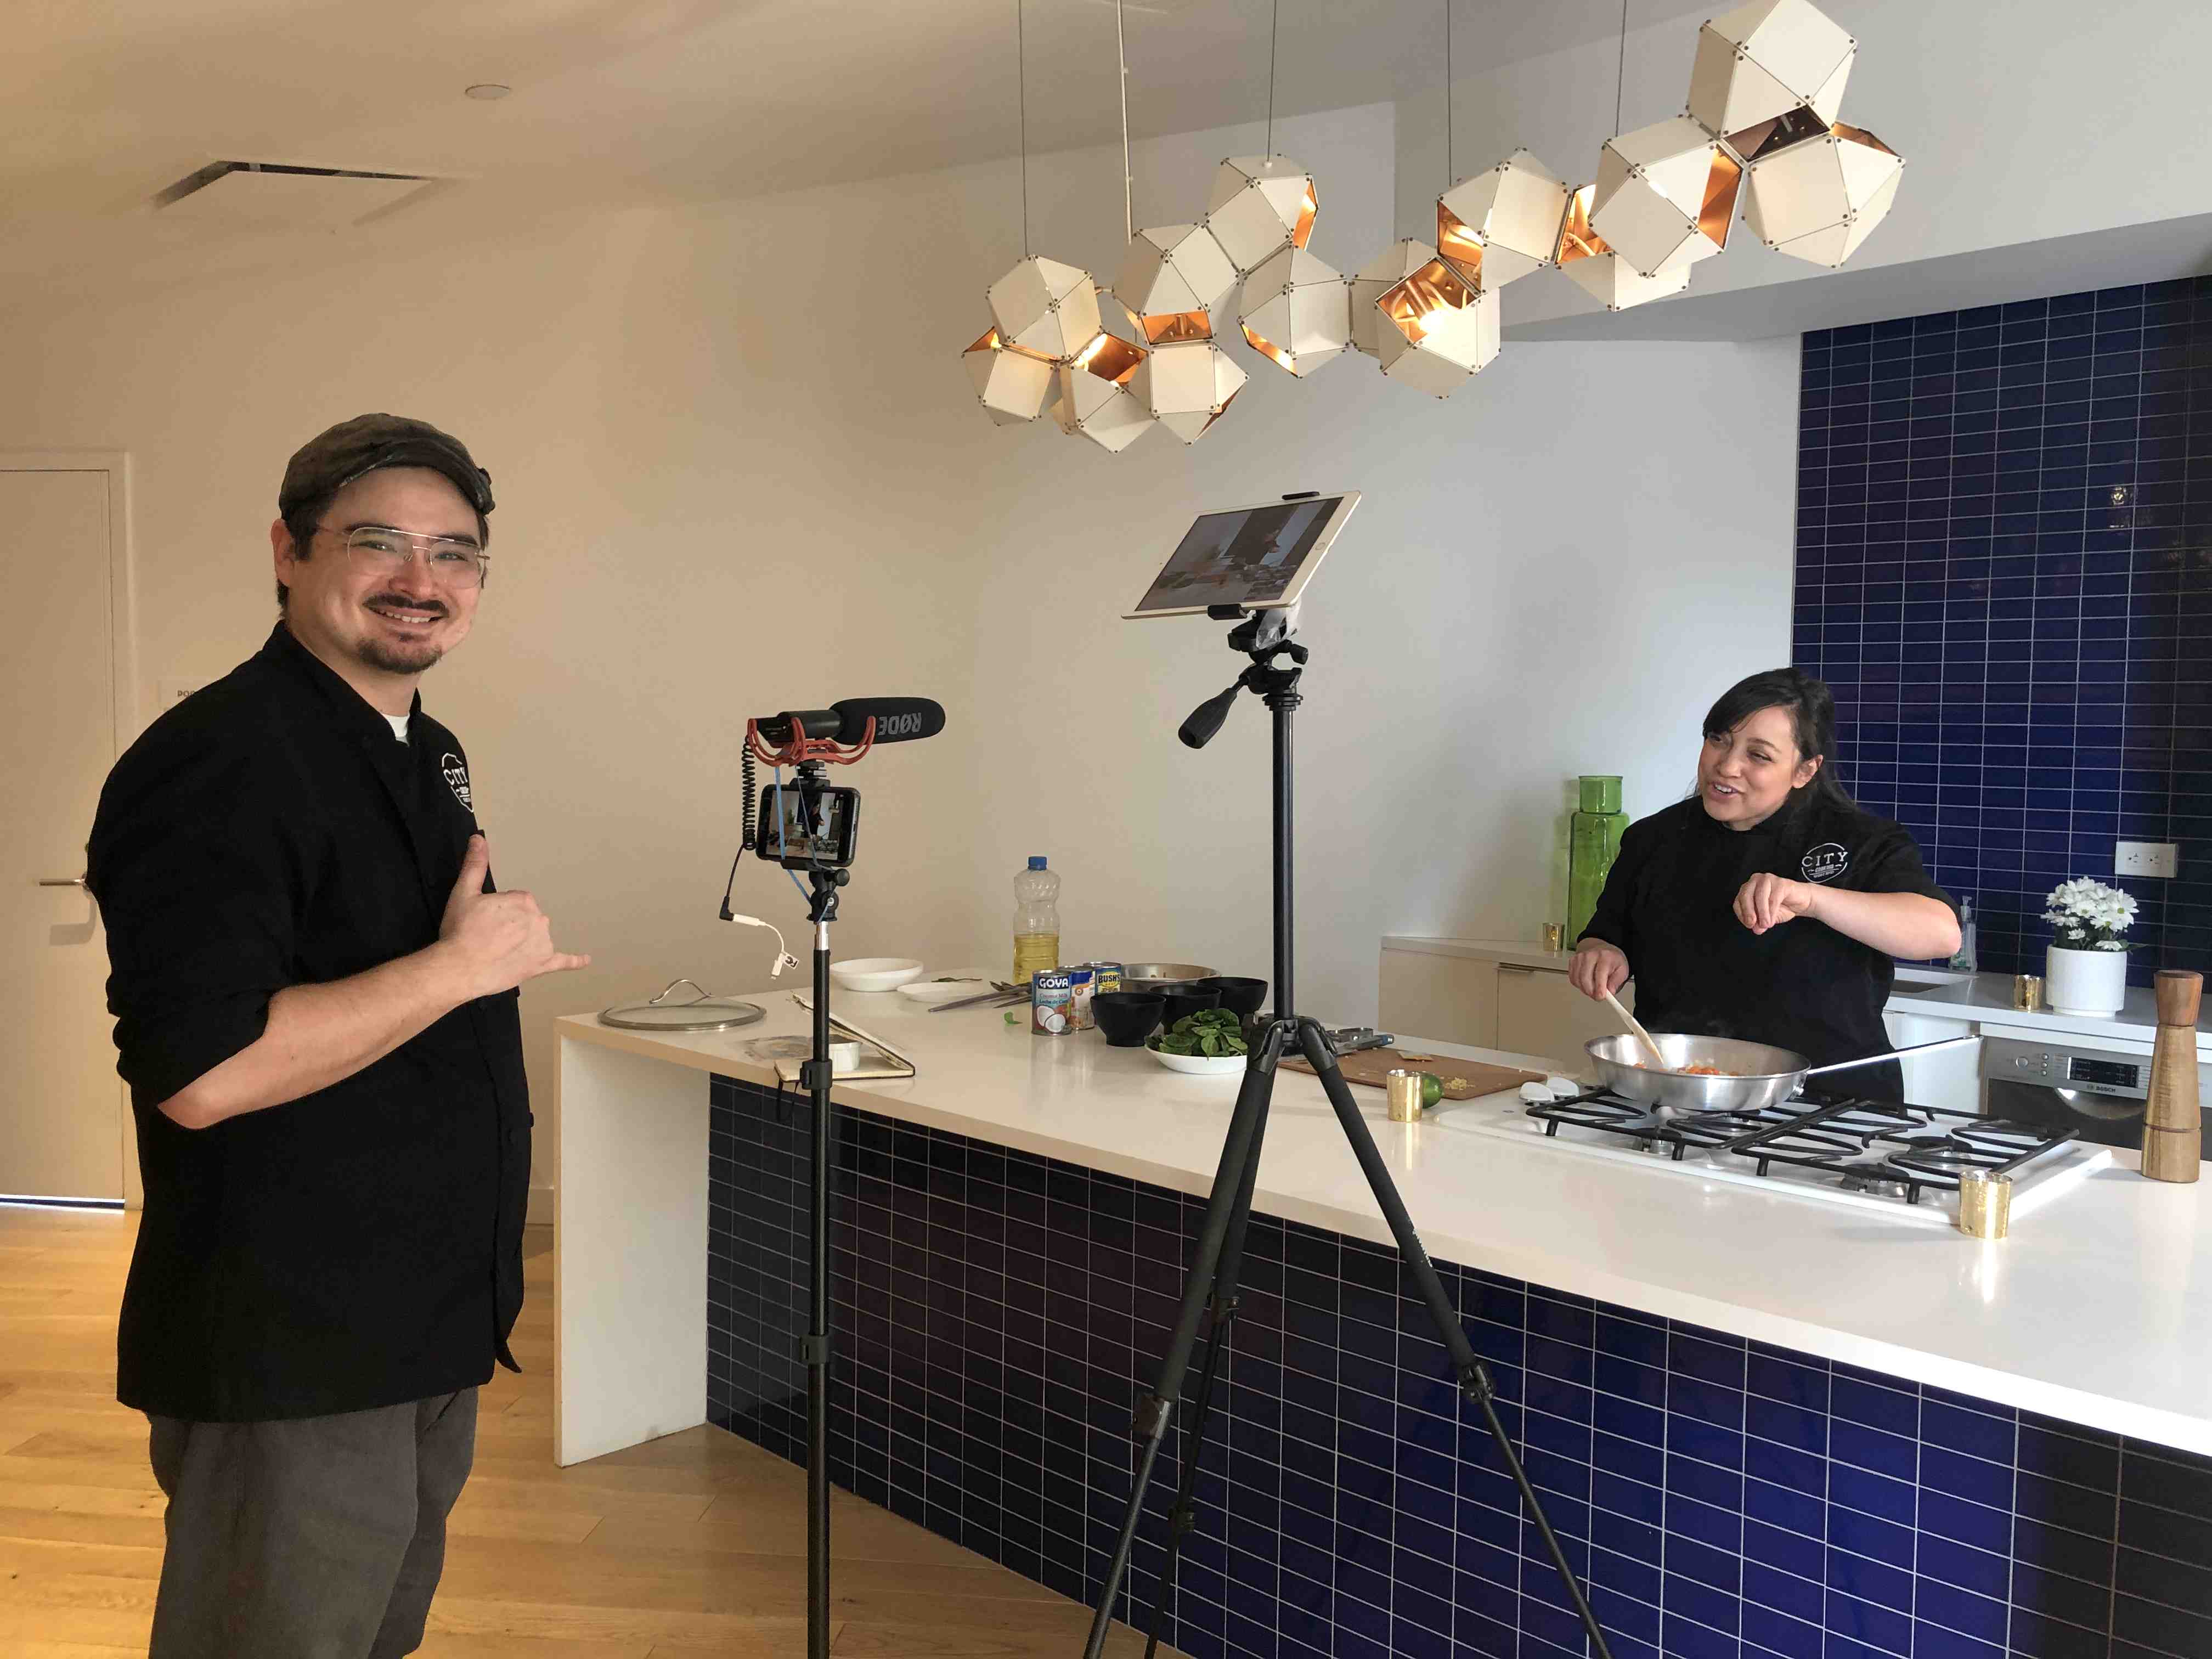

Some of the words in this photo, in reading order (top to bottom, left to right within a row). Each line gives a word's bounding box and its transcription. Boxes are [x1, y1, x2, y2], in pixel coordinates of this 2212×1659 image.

[878, 713, 922, 736] RØDE
[443, 767, 468, 785] CITY
[1802, 851, 1848, 867] CITY
[1039, 978, 1069, 988] GOYA
